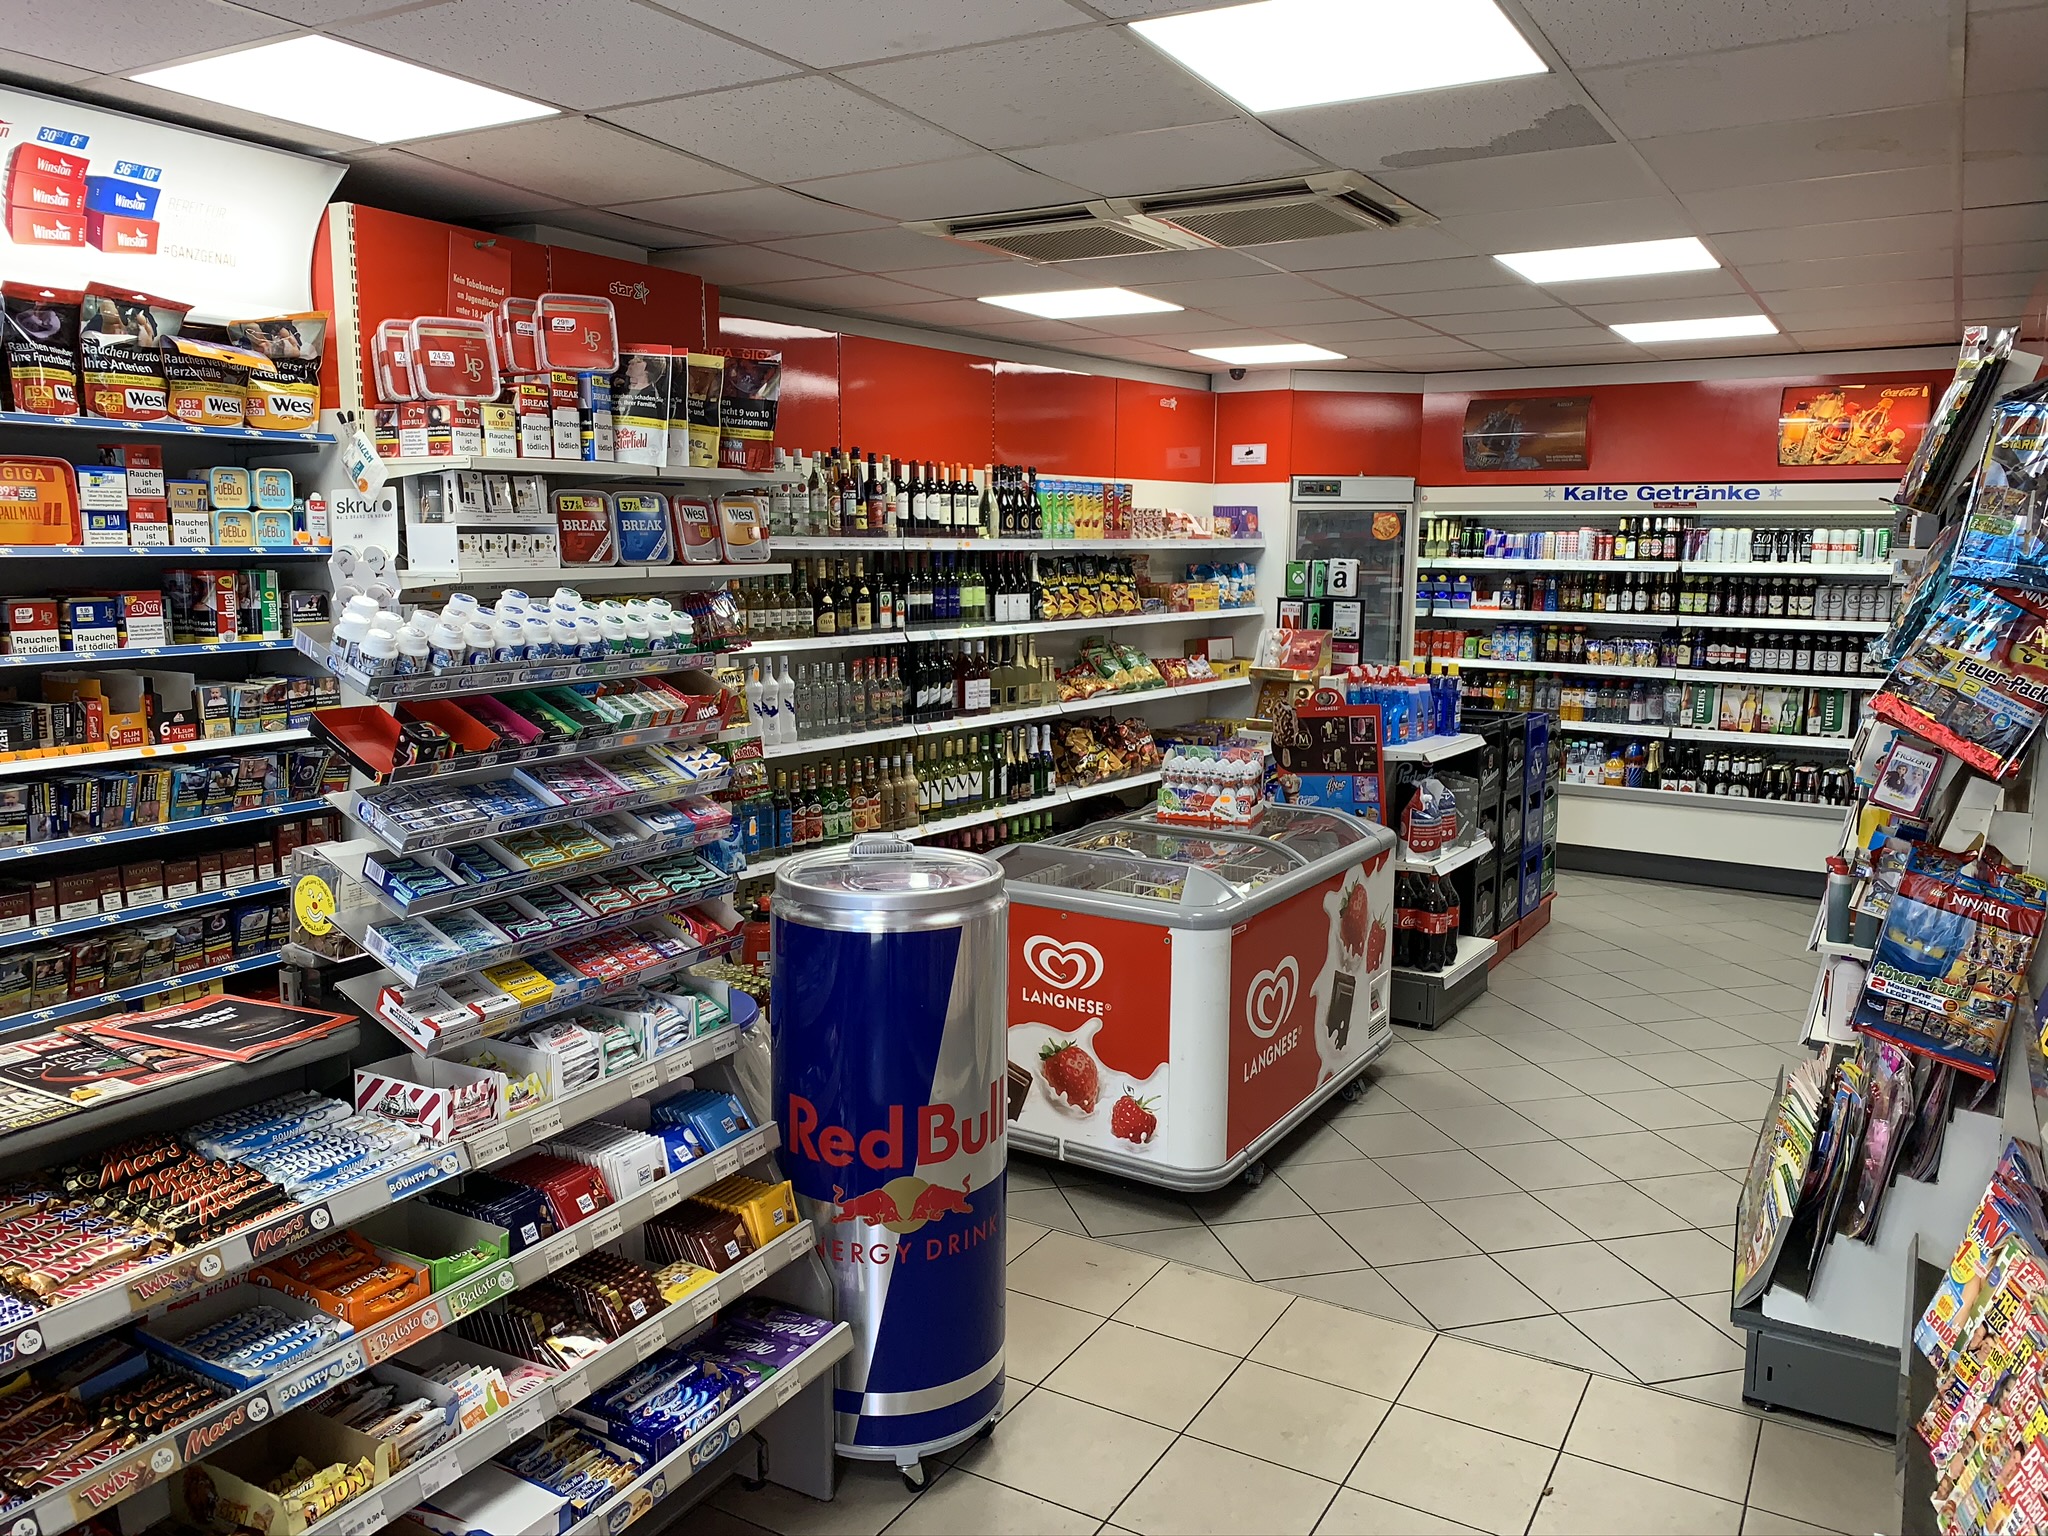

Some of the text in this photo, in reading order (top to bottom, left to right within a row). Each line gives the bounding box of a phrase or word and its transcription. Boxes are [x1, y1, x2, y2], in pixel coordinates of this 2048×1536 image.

[37, 157, 71, 176] Winston
[33, 188, 69, 207] Winston
[115, 193, 146, 211] Winston
[33, 224, 70, 241] Winston
[117, 232, 147, 248] Winston
[453, 273, 505, 296] Kein Tabakverkauf
[609, 281, 633, 298] star
[456, 305, 480, 318] unter 18
[581, 326, 601, 352] JPS
[11, 352, 31, 362] Ihre
[82, 343, 128, 360] Rauchen
[84, 357, 153, 374] Ihre Arterien
[164, 353, 205, 367] Rauchen
[461, 353, 485, 382] JPS
[165, 366, 222, 379] Herzanfälle
[251, 368, 295, 382] Arterien
[129, 391, 166, 407] West
[553, 389, 579, 399] BREAK
[209, 398, 242, 414] West
[522, 398, 549, 408] BREAK
[745, 410, 760, 418] von
[760, 410, 770, 419] 10
[523, 423, 550, 433] Rauchen
[554, 419, 580, 429] Rauchen
[488, 433, 513, 441] Rauchen
[533, 433, 543, 441] ist
[563, 430, 573, 439] ist
[459, 444, 479, 452] tödlich
[492, 446, 513, 454] tödlich
[527, 442, 550, 451] tödlich
[557, 440, 580, 451] tödlich
[729, 451, 747, 466] MALL
[3, 468, 46, 481] GIGA
[129, 470, 163, 478] Rauchen
[141, 478, 152, 486] ist
[18, 488, 36, 498] 555
[134, 487, 161, 495] tödlich
[214, 486, 243, 497] PUEBLO
[259, 487, 286, 497] PUEBLO
[1564, 484, 1760, 502] Kalte Getränke
[20, 506, 41, 521] MALL
[684, 507, 707, 520] West
[728, 508, 754, 521] West
[133, 524, 168, 532] Rauchen
[174, 519, 208, 527] Rauchen
[562, 519, 607, 532] BREAK
[622, 519, 663, 531] BREAK
[145, 532, 156, 540] ist
[180, 536, 206, 544] tödlich
[219, 528, 247, 538] PUEBLO
[258, 528, 286, 538] PUEBLO
[225, 590, 235, 618] ducal
[268, 600, 277, 632] ducal
[16, 636, 57, 645] Rauchen
[77, 634, 116, 642] Rauchen
[12, 644, 60, 655] ist tödlich
[87, 642, 118, 652] tödlich
[1959, 680, 1981, 697] 2
[1696, 688, 1706, 720] VELTINS
[1980, 686, 2025, 712] Magazine
[1824, 695, 1834, 728] VELTINS
[1976, 694, 2034, 726] LEGO Extras
[75, 719, 84, 740] OCB
[109, 725, 140, 740] 6 SLIM
[160, 721, 171, 736] 6
[178, 731, 195, 740] FILTER
[123, 736, 141, 744] FILTER
[1895, 750, 1925, 766] FROZEN
[90, 777, 99, 815] DRUM
[126, 782, 135, 810] DRUM
[128, 866, 158, 877] MOODS
[62, 878, 94, 889] MOODS
[1930, 887, 2010, 923] LEGO NINJAGO
[1870, 977, 1887, 992] 2
[1887, 981, 1933, 1000] Magazine
[1022, 987, 1104, 1016] LANGNESE
[1885, 988, 1942, 1012] LEGO Extras
[1243, 1030, 1299, 1083] LANGNESE
[789, 1074, 1004, 1170] Red Bull
[99, 1143, 183, 1190] Mars
[128, 1151, 206, 1195] Mars
[444, 1161, 457, 1171] 1,30
[151, 1160, 226, 1199] Mars
[171, 1160, 246, 1205] Mars
[389, 1171, 429, 1194] BOUNTY
[314, 1214, 327, 1225] 1,30
[252, 1212, 304, 1258] Mars
[284, 1227, 310, 1247] 2 PACK
[814, 1214, 998, 1264] NERGY DRINK
[1969, 1226, 1994, 1259] direkt
[291, 1234, 349, 1270] Balisto
[1956, 1240, 1973, 1264] 1
[203, 1262, 218, 1273] 1,30
[133, 1268, 178, 1300] Twix
[337, 1264, 388, 1297] Balisto
[499, 1276, 513, 1287] 0,90
[457, 1275, 498, 1310] Balisto
[423, 1315, 437, 1325] 0,90
[238, 1320, 312, 1359] BOUNTY
[376, 1316, 421, 1352] Balisto
[21, 1338, 38, 1350] 1,30
[250, 1328, 324, 1369] BOUNTY
[345, 1359, 360, 1370] 0,90
[280, 1370, 330, 1402] BOUNTY
[252, 1407, 268, 1418] 0,90
[184, 1405, 247, 1462] Mars
[153, 1455, 172, 1467] 0,90
[80, 1464, 140, 1508] Twix
[290, 1479, 315, 1498] WHITE
[319, 1468, 367, 1512] LION
[366, 1513, 381, 1526] 0,90
